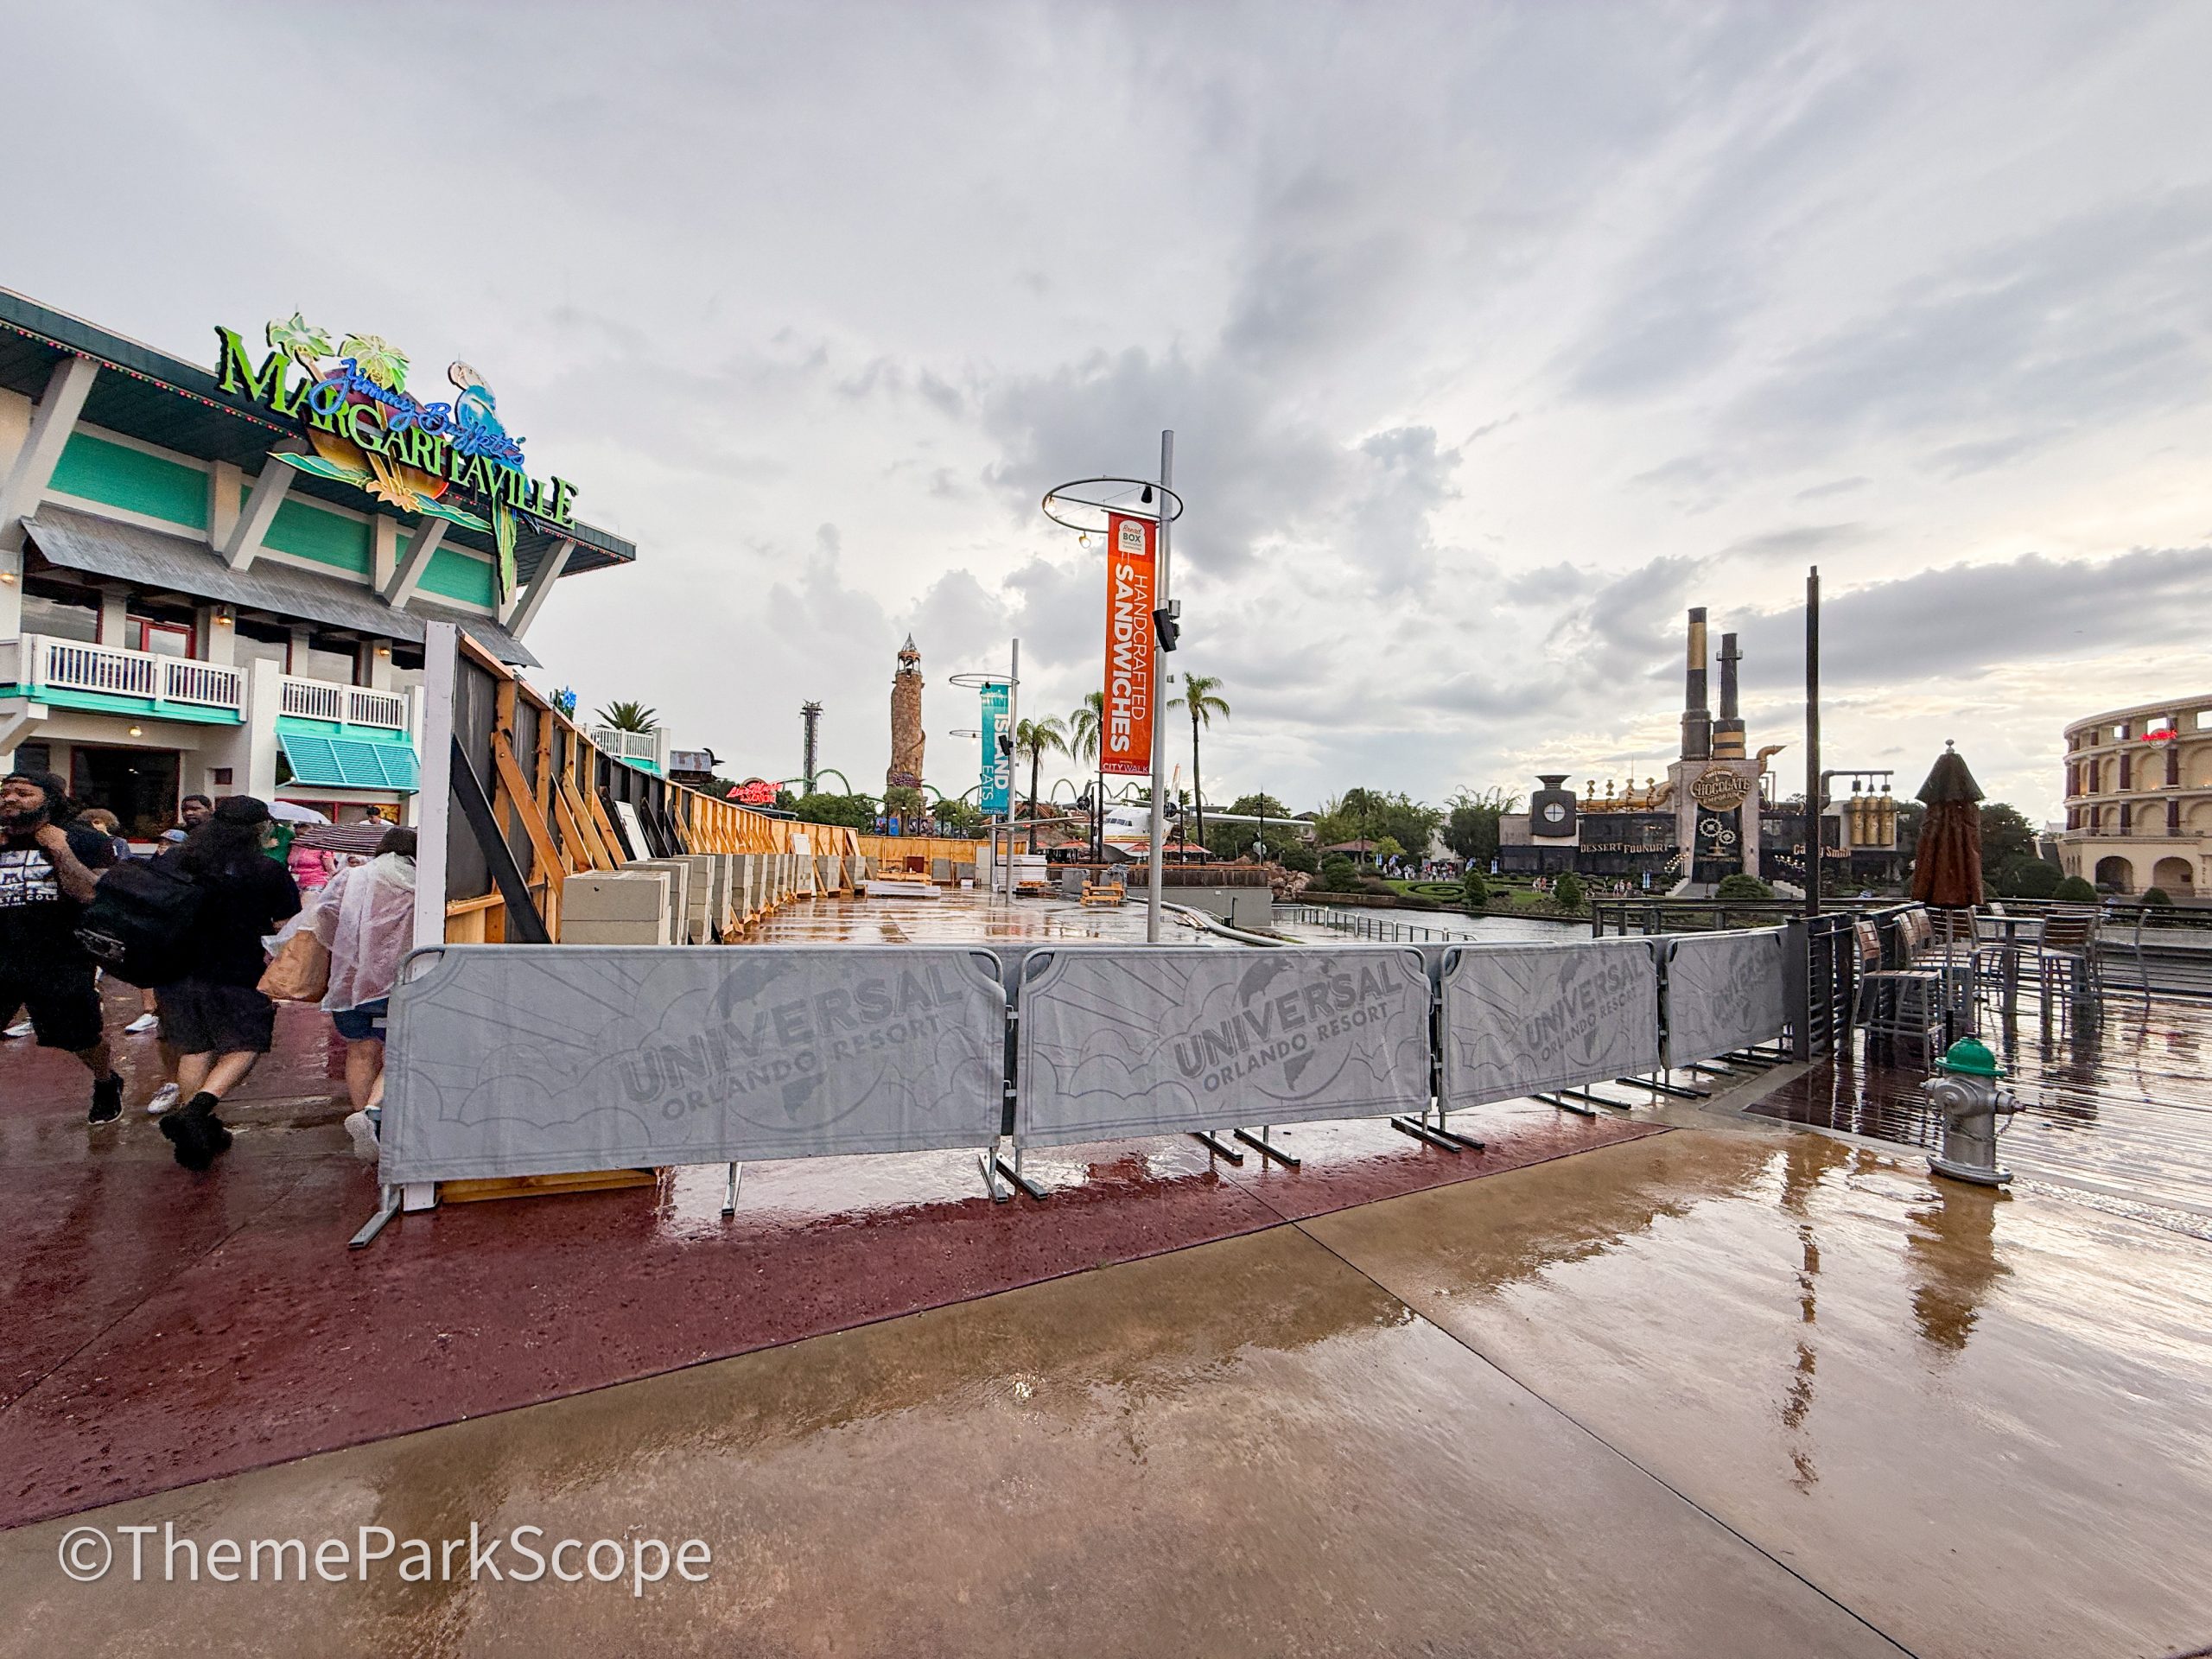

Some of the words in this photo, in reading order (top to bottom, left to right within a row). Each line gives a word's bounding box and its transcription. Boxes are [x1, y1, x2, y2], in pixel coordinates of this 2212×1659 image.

[214, 325, 579, 530] MARGARITAVILLE
[308, 358, 418, 432] Jimmy
[418, 402, 525, 466] Buffett's
[1123, 532, 1141, 543] BOX
[1109, 563, 1135, 753] SANDWICHES
[1131, 575, 1148, 721] HANDCRAFTED
[982, 765, 994, 800] EATS
[1689, 777, 1751, 799] CHOCOLATE
[1703, 791, 1740, 804] EMPORIUM
[1580, 842, 1623, 853] DESSERT
[1624, 844, 1669, 854] FOUNDRY
[1793, 843, 1824, 858] Cay
[620, 967, 965, 1103] UNIVERSAL
[1174, 959, 1404, 1078] UNIVERSAL
[1203, 1033, 1307, 1092] ORLANDO
[1317, 1001, 1389, 1043] RESORT
[1526, 953, 1646, 1052] UNIVERSAL
[1541, 1013, 1597, 1062] ORLANDO
[662, 1051, 821, 1122] ORLANDO
[832, 1013, 945, 1061] RESORT
